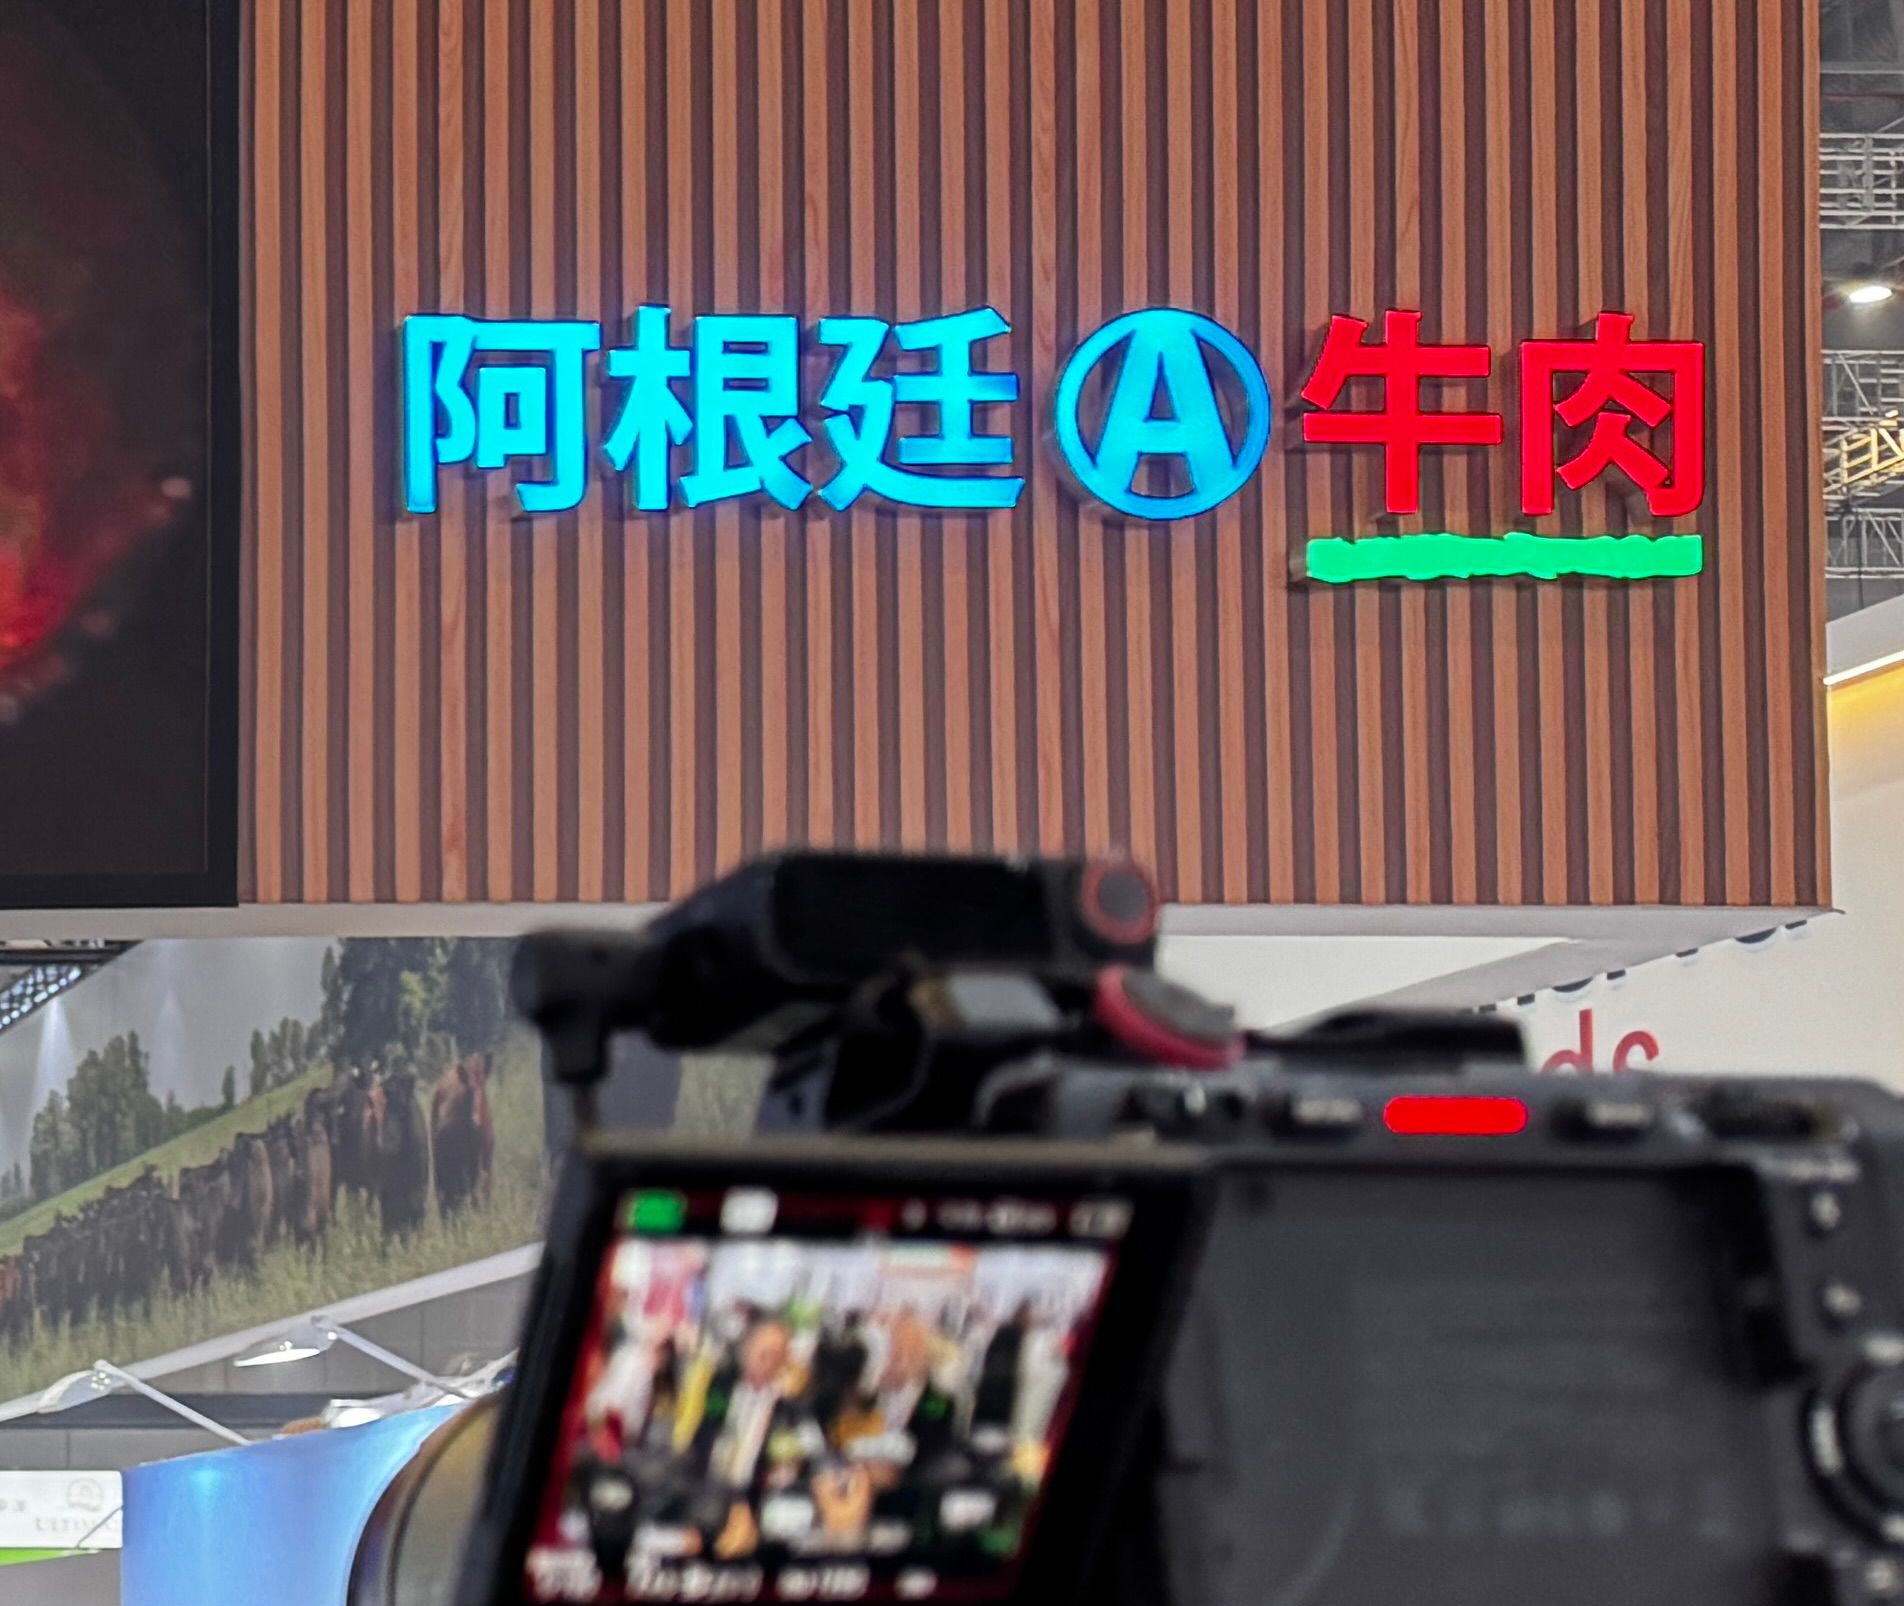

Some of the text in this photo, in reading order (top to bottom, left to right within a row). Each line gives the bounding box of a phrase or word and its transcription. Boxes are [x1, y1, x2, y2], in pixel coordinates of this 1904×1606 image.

[399, 305, 1025, 513] 阿根廷
[1302, 309, 1706, 516] 牛肉
